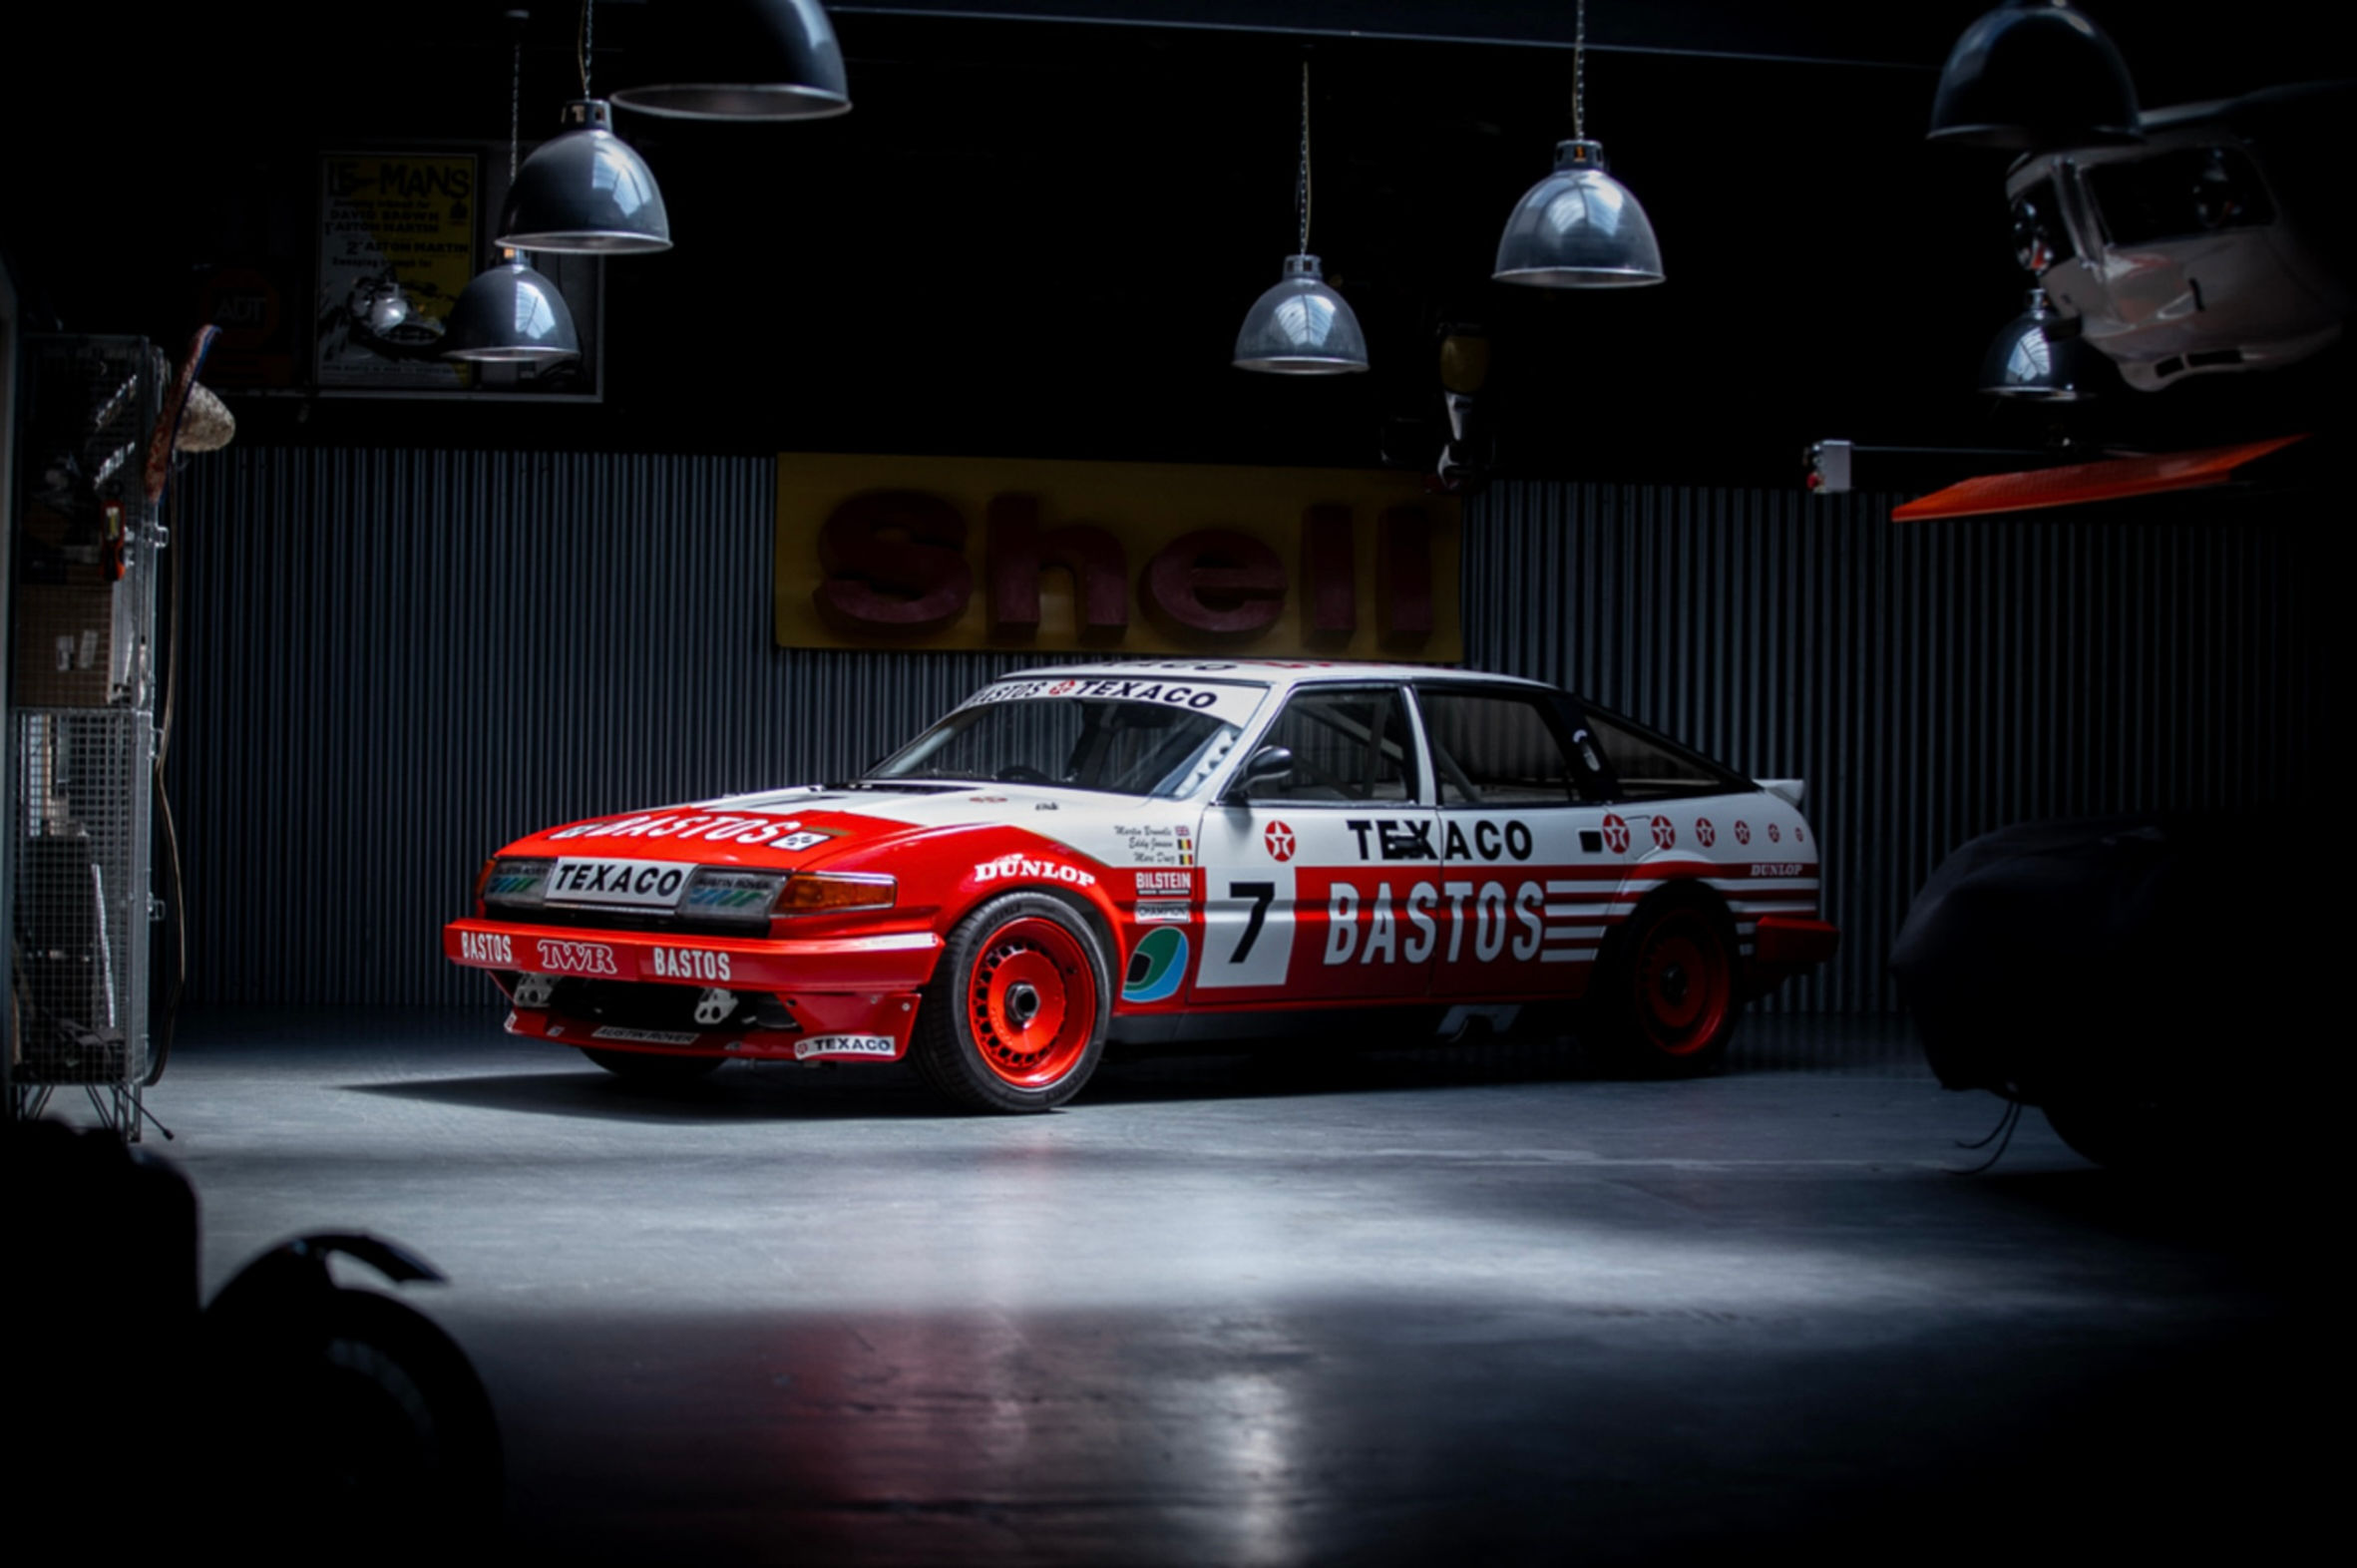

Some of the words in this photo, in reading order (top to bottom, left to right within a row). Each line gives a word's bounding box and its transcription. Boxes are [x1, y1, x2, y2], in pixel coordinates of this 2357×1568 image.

[812, 489, 1433, 652] Shell
[1074, 680, 1218, 709] TEXACO
[585, 815, 801, 845] BASTOS
[1346, 820, 1533, 861] TEXACO
[556, 864, 682, 897] TEXACO
[975, 858, 1095, 887] DUNLOP
[1135, 872, 1191, 890] BILSTEIN
[1751, 864, 1803, 877] DUNLOP
[1228, 882, 1276, 965] 7
[1323, 880, 1545, 966] BASTOS
[461, 931, 513, 964] BASTOS
[537, 939, 618, 975] TWR
[653, 947, 731, 981] BASTOS
[814, 1037, 890, 1052] TEXACO
